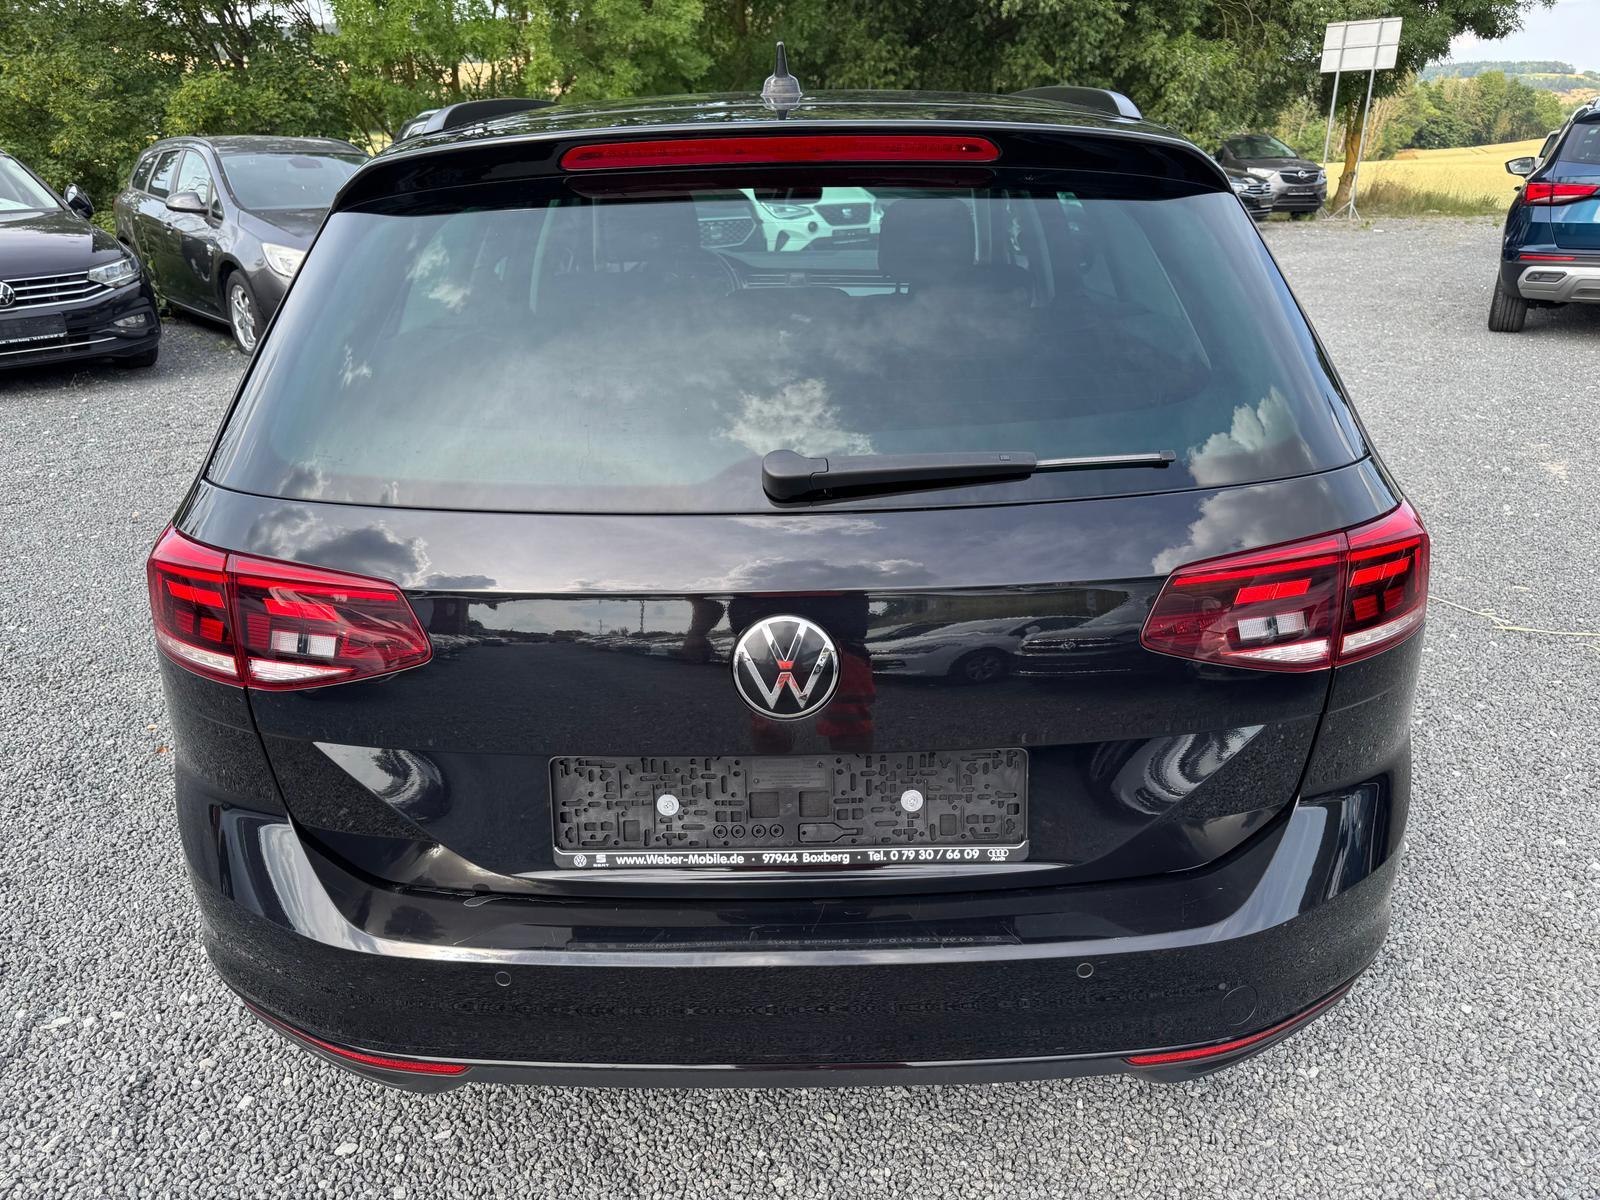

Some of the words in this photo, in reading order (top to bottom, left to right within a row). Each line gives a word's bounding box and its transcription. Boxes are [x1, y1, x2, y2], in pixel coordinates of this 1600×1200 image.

[616, 853, 745, 865] www.Weber-Mobile.de
[762, 853, 799, 864] 97944
[802, 852, 850, 864] Boxberg
[867, 850, 887, 861] Tel.
[890, 850, 899, 861] 0
[901, 850, 916, 860] 79
[918, 849, 934, 860] 30
[946, 849, 961, 860] 66
[963, 849, 980, 860] 09
